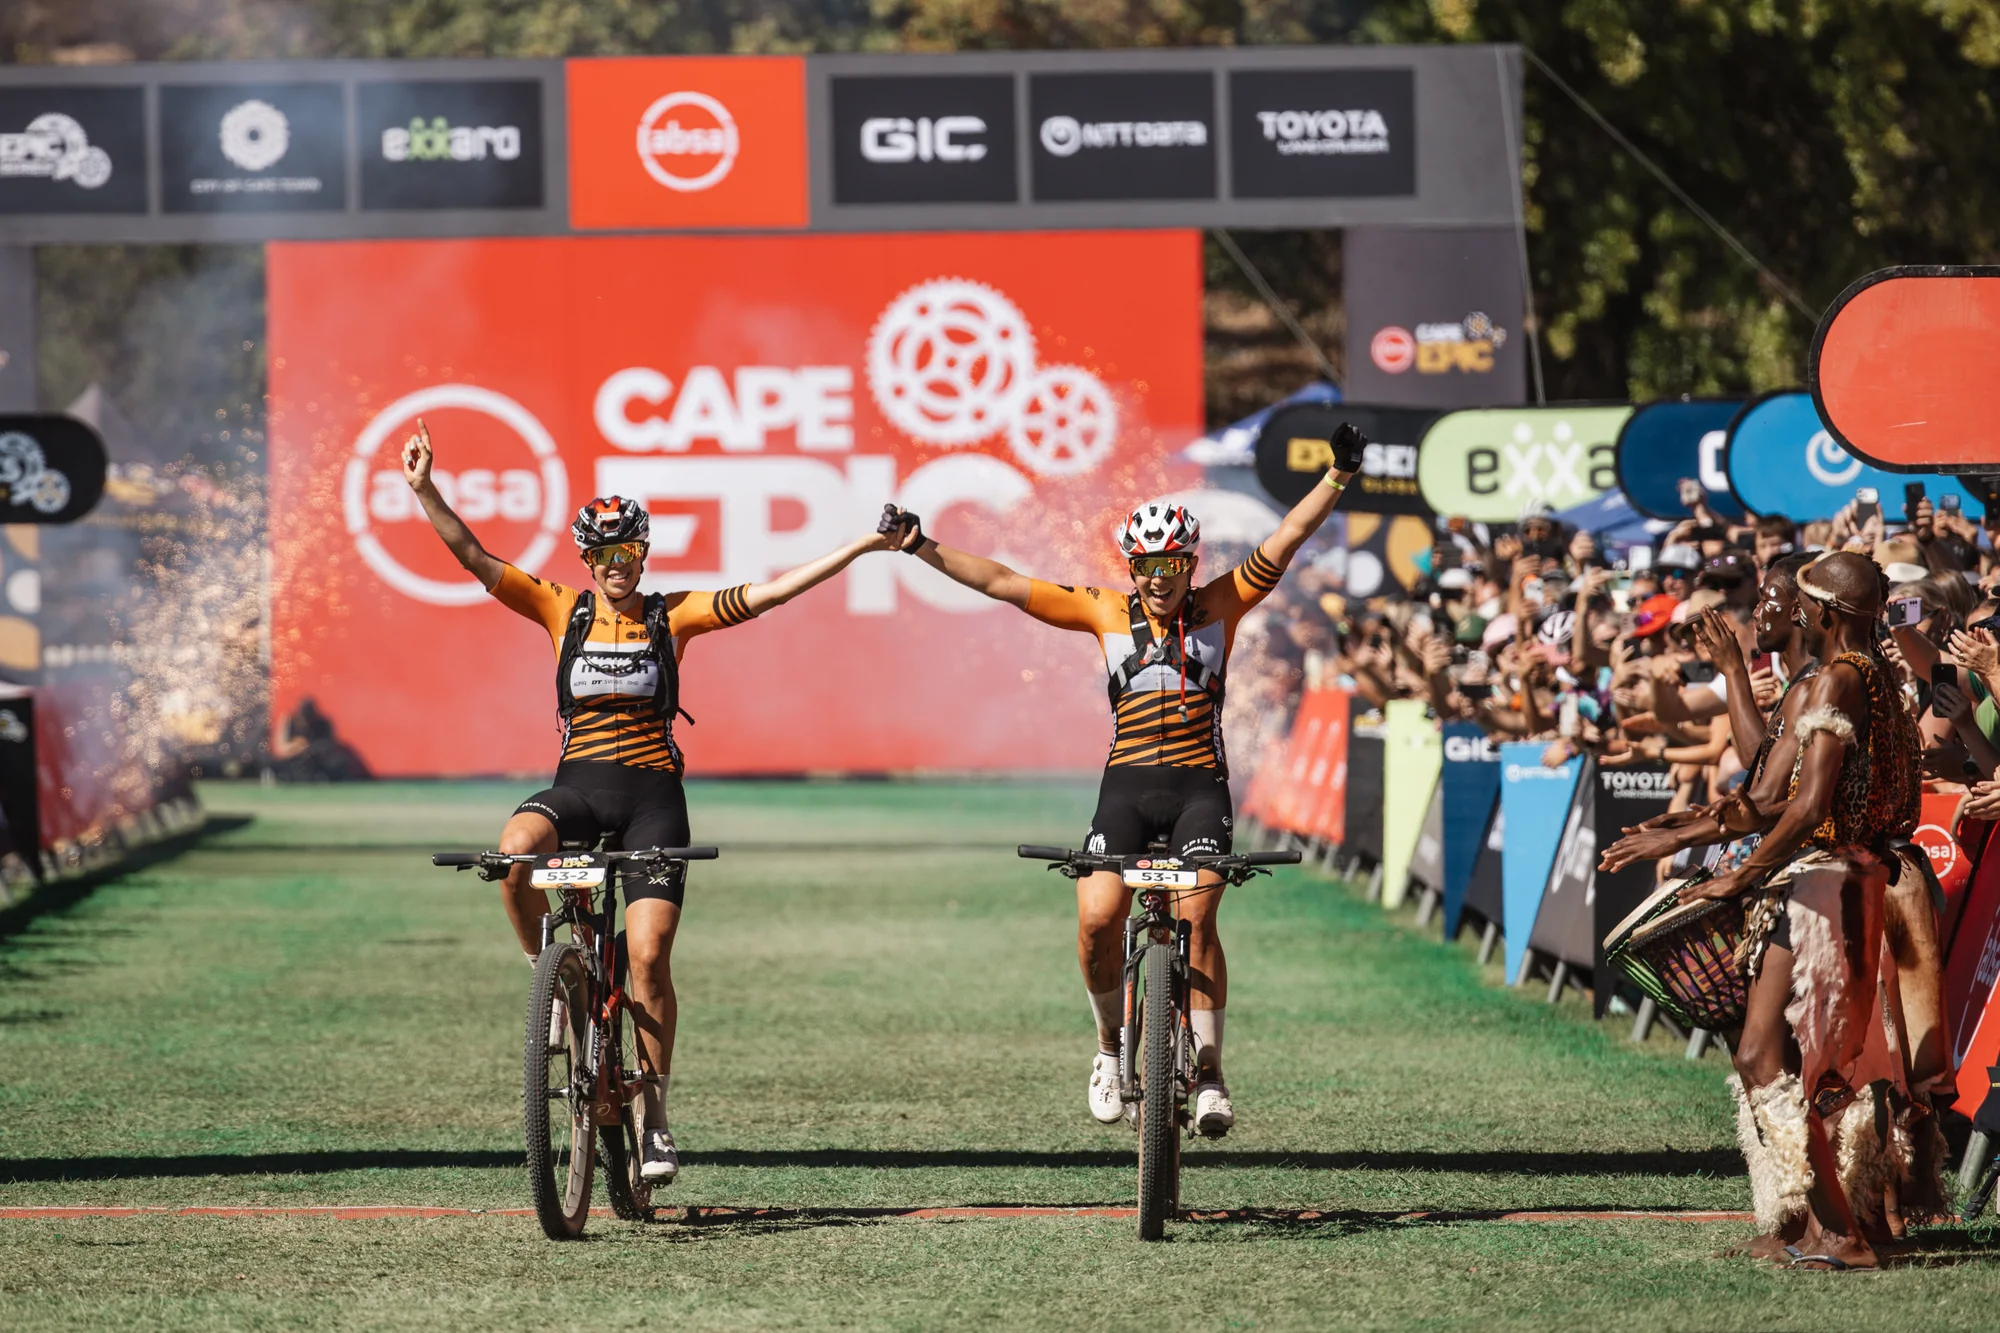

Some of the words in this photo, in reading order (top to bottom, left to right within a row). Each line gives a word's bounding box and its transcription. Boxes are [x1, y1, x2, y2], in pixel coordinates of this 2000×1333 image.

[382, 116, 521, 162] exxaro
[650, 120, 724, 155] absa
[860, 115, 988, 163] GIC
[1256, 109, 1388, 140] TOYOTA
[1416, 340, 1495, 374] EPIC
[594, 365, 854, 453] CAPE
[594, 452, 1035, 615] EPIC
[521, 802, 559, 820] maxon
[1182, 838, 1218, 852] SPIER
[547, 871, 589, 881] 53-2
[562, 860, 589, 868] EPIC
[1141, 872, 1179, 882] 53-1
[1152, 862, 1179, 870] EPIC
